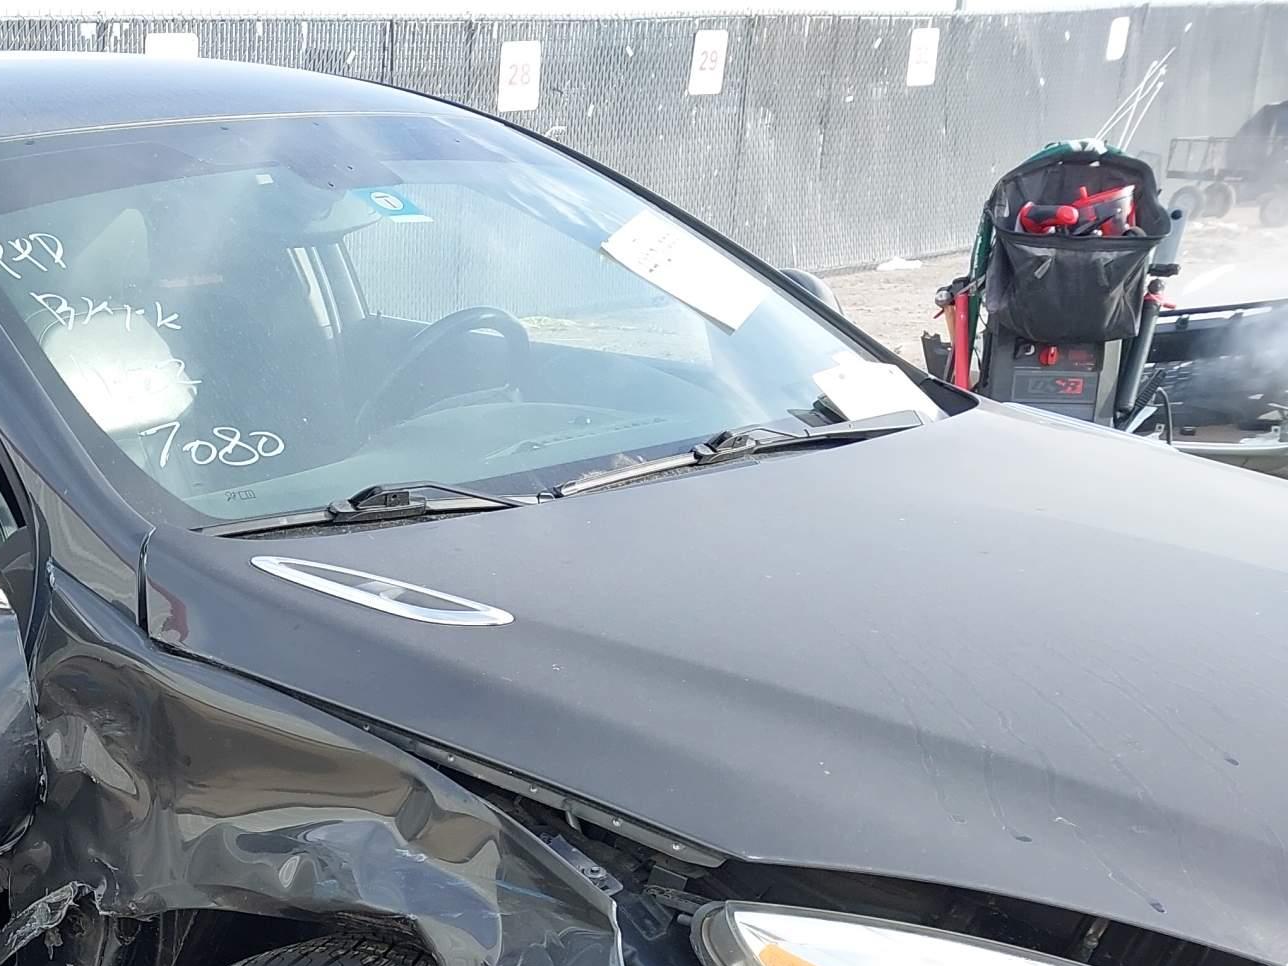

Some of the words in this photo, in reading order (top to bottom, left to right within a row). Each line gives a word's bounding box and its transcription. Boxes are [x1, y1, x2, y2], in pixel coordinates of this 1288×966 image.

[699, 50, 718, 71] 29
[508, 63, 531, 86] 28
[136, 420, 285, 469] 7080
